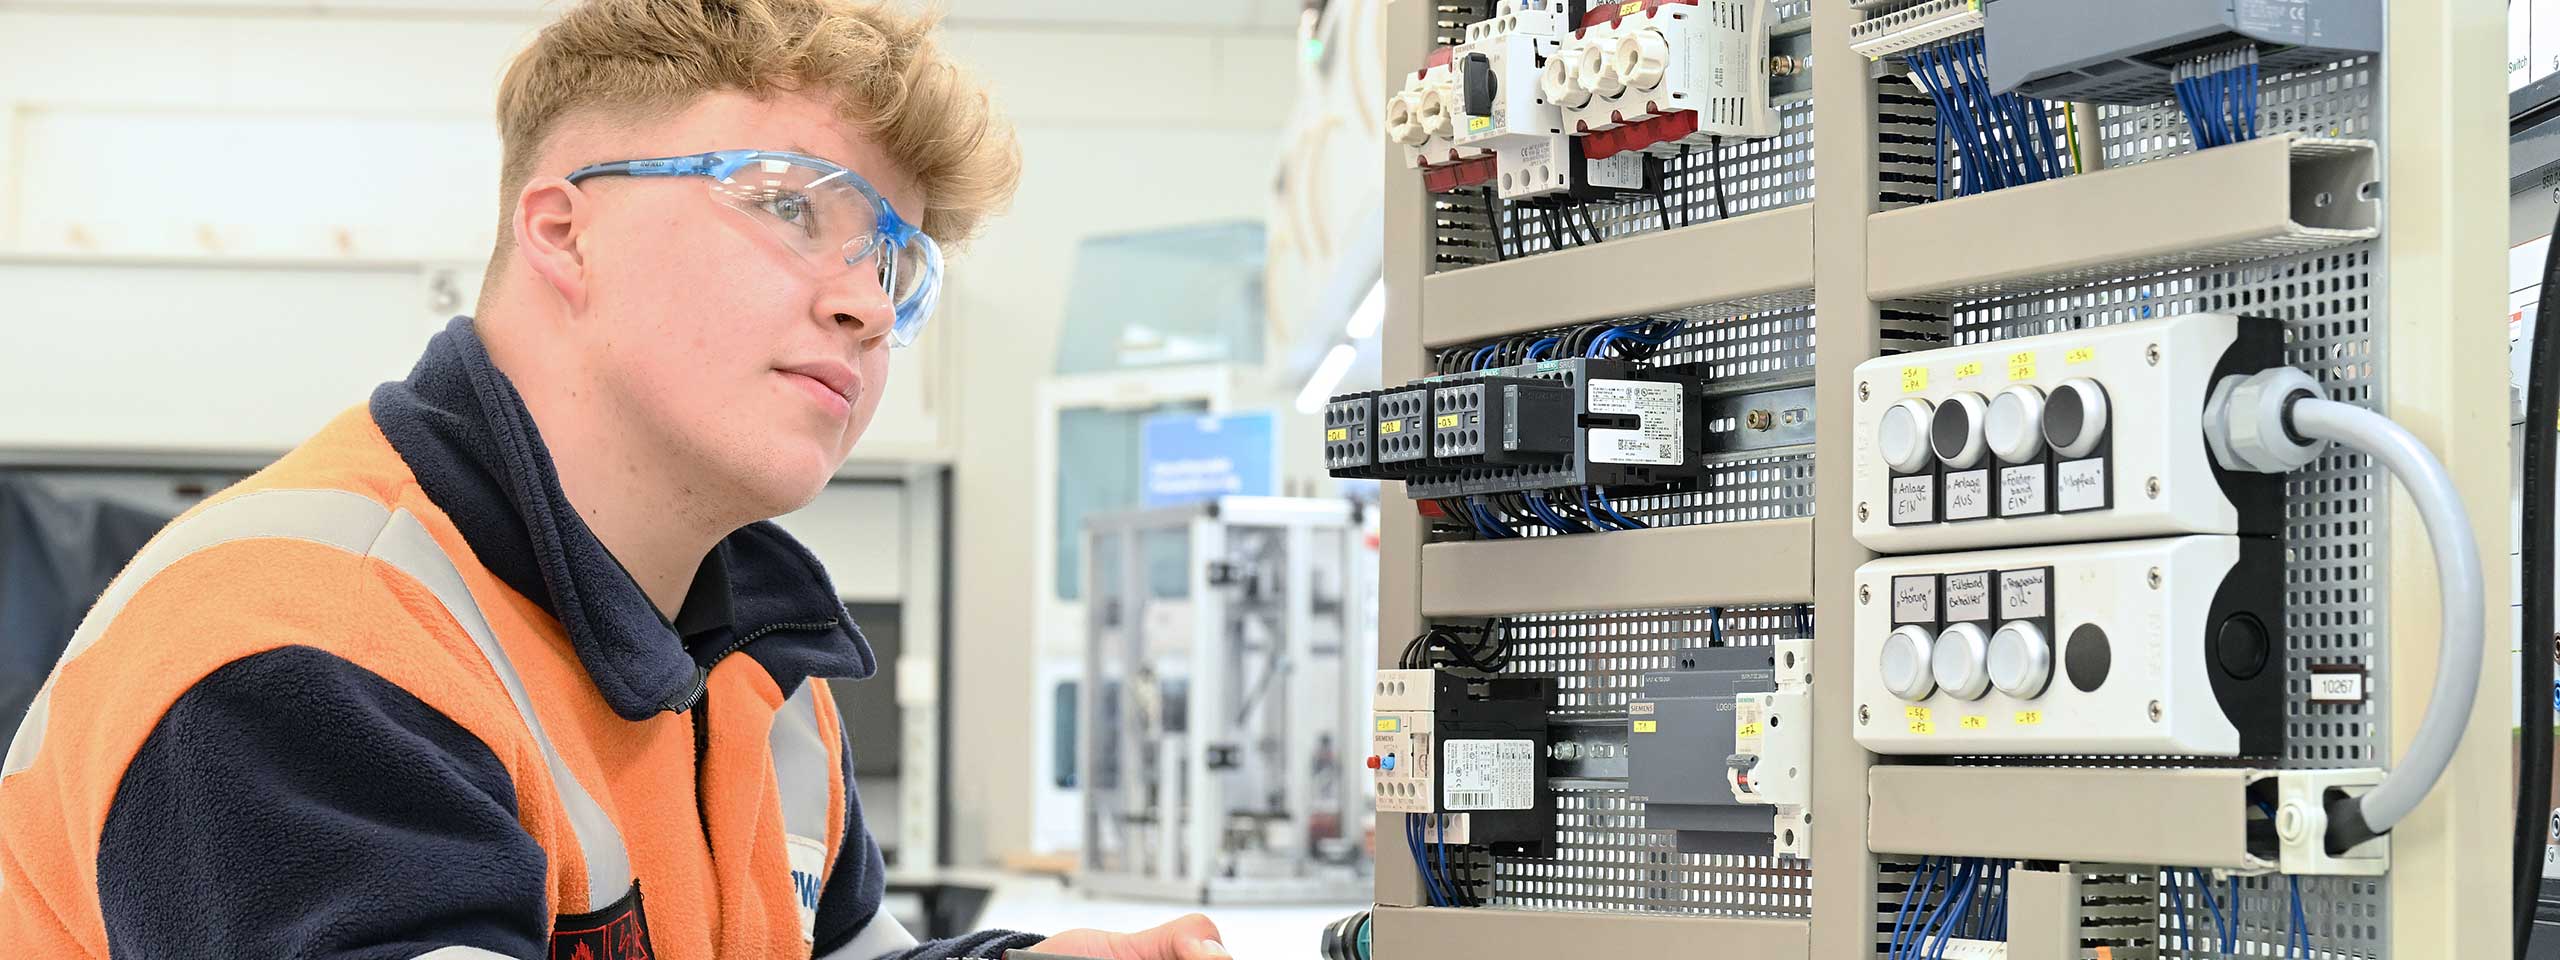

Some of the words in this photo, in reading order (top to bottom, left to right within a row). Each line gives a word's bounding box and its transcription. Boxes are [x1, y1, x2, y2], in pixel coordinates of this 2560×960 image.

[2508, 55, 2528, 75] Switch
[1714, 67, 1724, 87] ABB
[2322, 679, 2353, 694] 10267
[1630, 704, 1653, 713] SIEMENS
